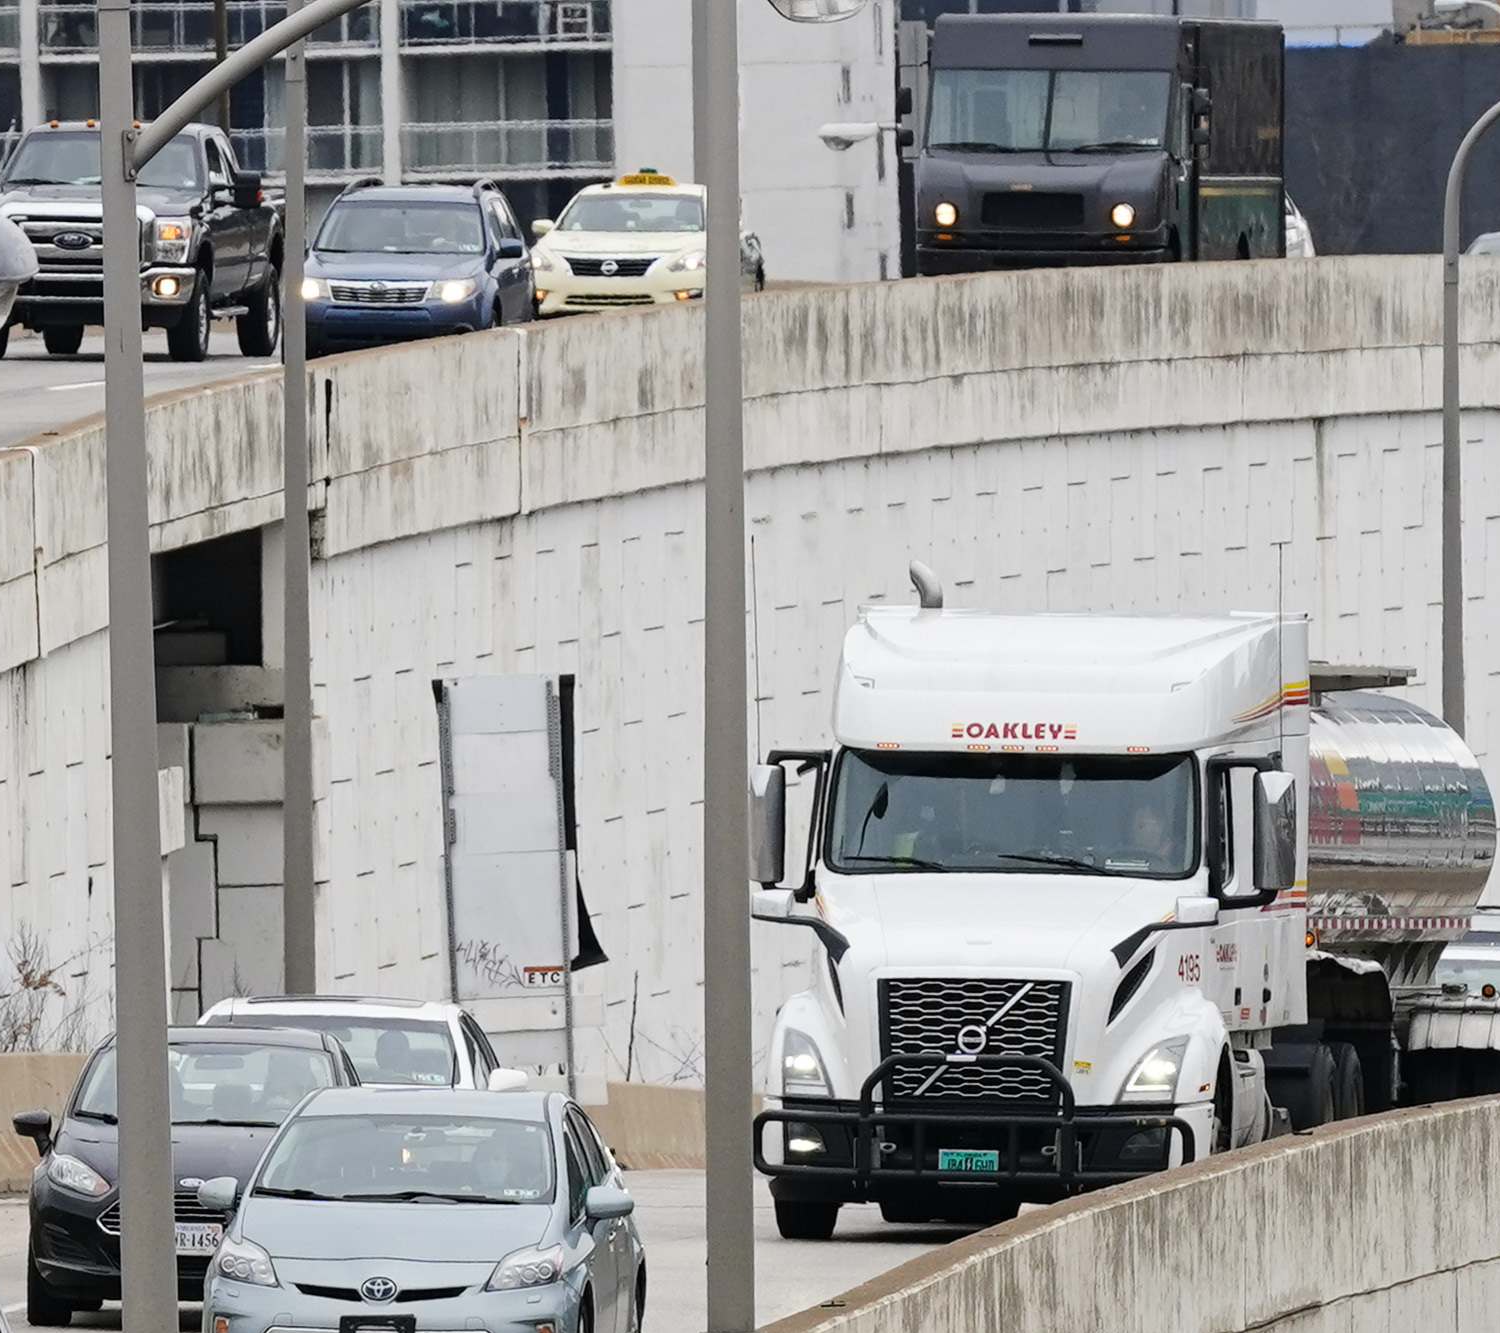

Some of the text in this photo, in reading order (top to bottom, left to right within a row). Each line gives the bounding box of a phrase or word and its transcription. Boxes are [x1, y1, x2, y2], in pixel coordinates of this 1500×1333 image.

[966, 722, 1063, 740] OAKLEY
[1178, 954, 1201, 982] 4195
[527, 971, 561, 984] ETC
